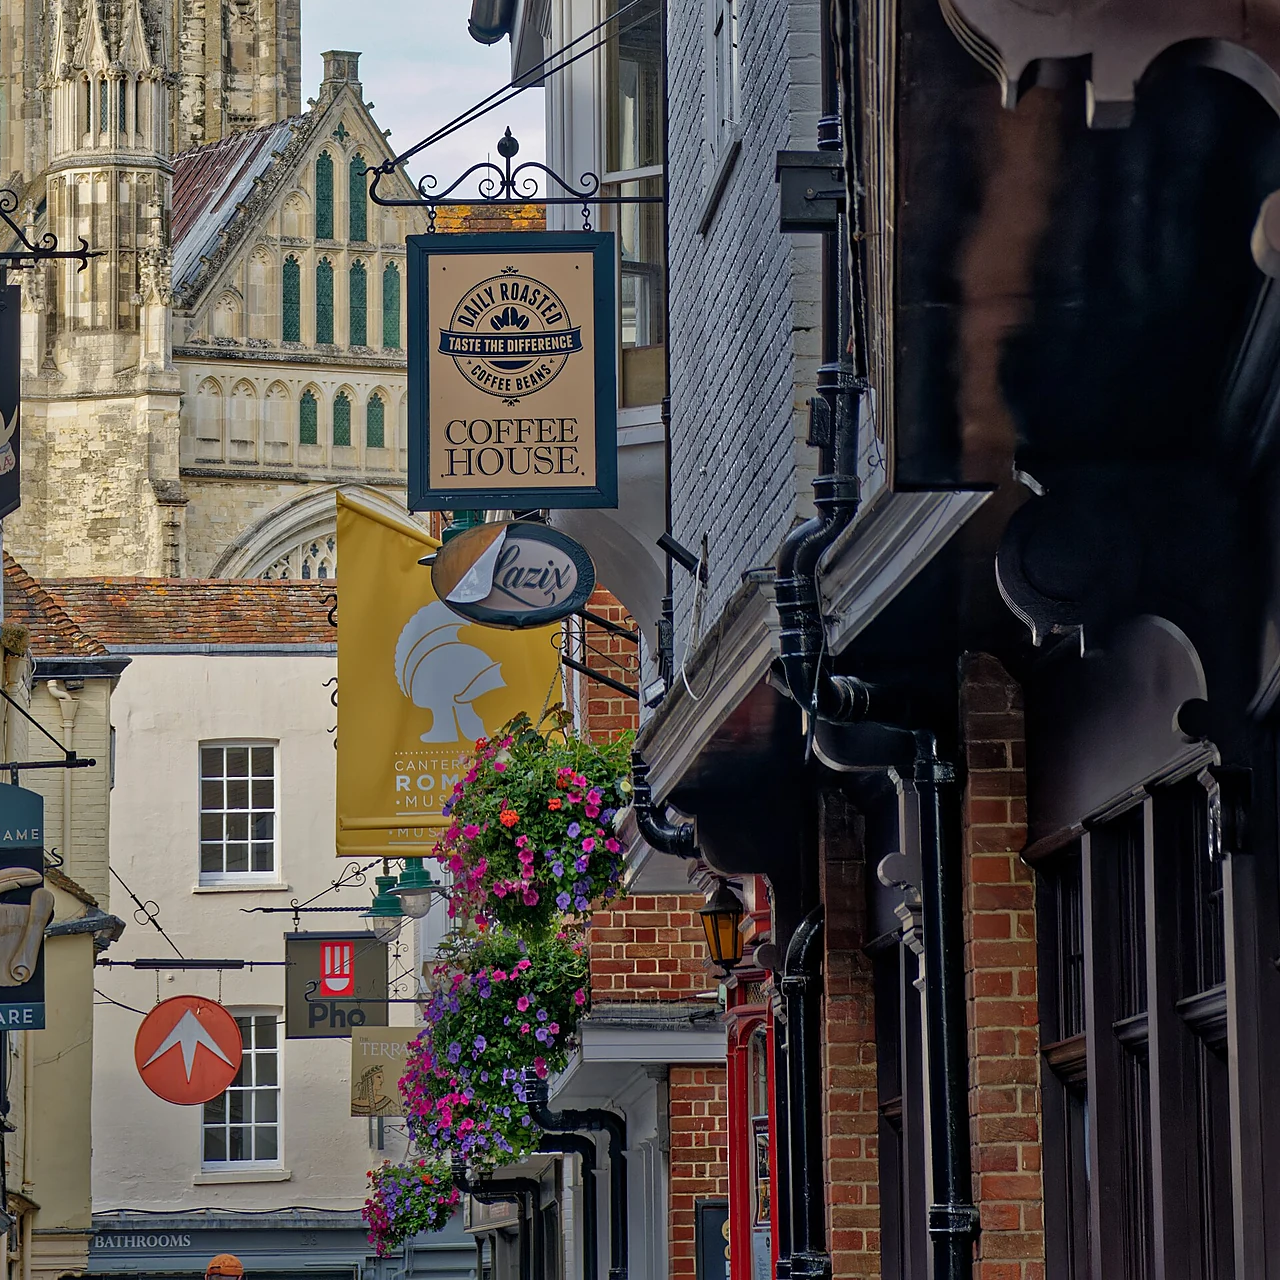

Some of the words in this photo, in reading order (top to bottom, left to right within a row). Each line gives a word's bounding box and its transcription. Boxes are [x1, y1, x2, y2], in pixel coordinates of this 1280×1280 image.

[457, 286, 496, 328] DAILY
[499, 282, 563, 325] ROASTED
[448, 336, 481, 352] TASTE
[484, 339, 505, 353] THE
[507, 334, 574, 353] DIFFERENCE
[470, 364, 512, 392] COFFEE
[515, 363, 552, 391] BEANS
[444, 418, 579, 445] COFFEE
[444, 446, 580, 476] HOUSE
[395, 773, 460, 792] ROM
[405, 794, 447, 808] MUS
[308, 1002, 367, 1029] Pho
[360, 1042, 411, 1060] TERRA
[93, 1234, 191, 1248] BATHROOMS
